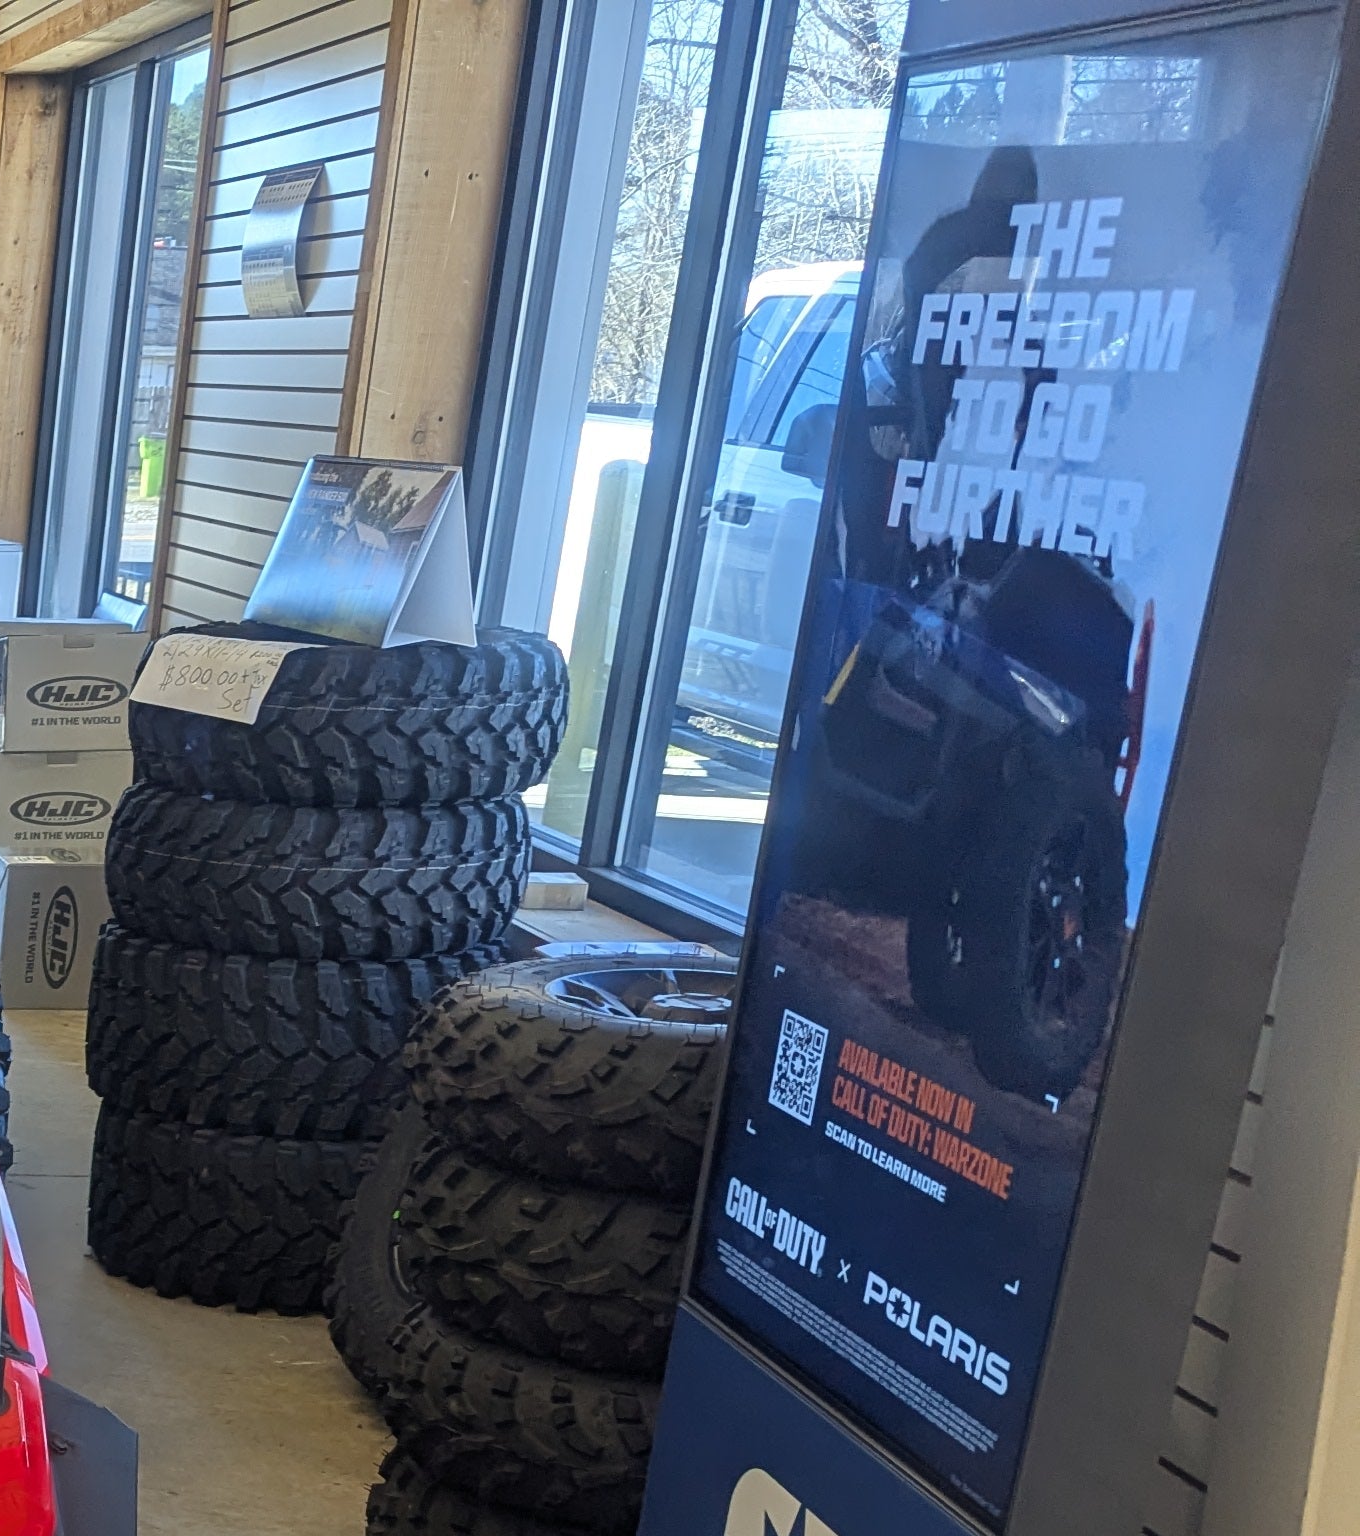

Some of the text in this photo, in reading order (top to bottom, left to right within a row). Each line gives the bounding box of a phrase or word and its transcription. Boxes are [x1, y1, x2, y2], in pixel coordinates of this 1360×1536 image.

[1008, 197, 1123, 280] THE
[912, 288, 1197, 371] FREEDOM
[951, 378, 1112, 462] TO GO
[887, 458, 1147, 558] FURTHER
[31, 716, 121, 726] #1 IN THE WORLD
[40, 684, 115, 703] HJC
[14, 831, 105, 840] #1 IN THE WORLD
[23, 800, 98, 818] HJC
[25, 944, 36, 984] WORLD
[29, 920, 38, 943] THE
[50, 900, 72, 975] HJC
[838, 1039, 976, 1134] AVAILABLE NOW IN
[824, 1120, 947, 1203] SCAN TO LEARN MORE
[832, 1075, 1014, 1200] CALL OF DUTY: WARZONE
[725, 1176, 767, 1239] CALL
[764, 1208, 778, 1230] OF
[772, 1207, 826, 1275] DUTY
[863, 1270, 1011, 1396] POLARIS
